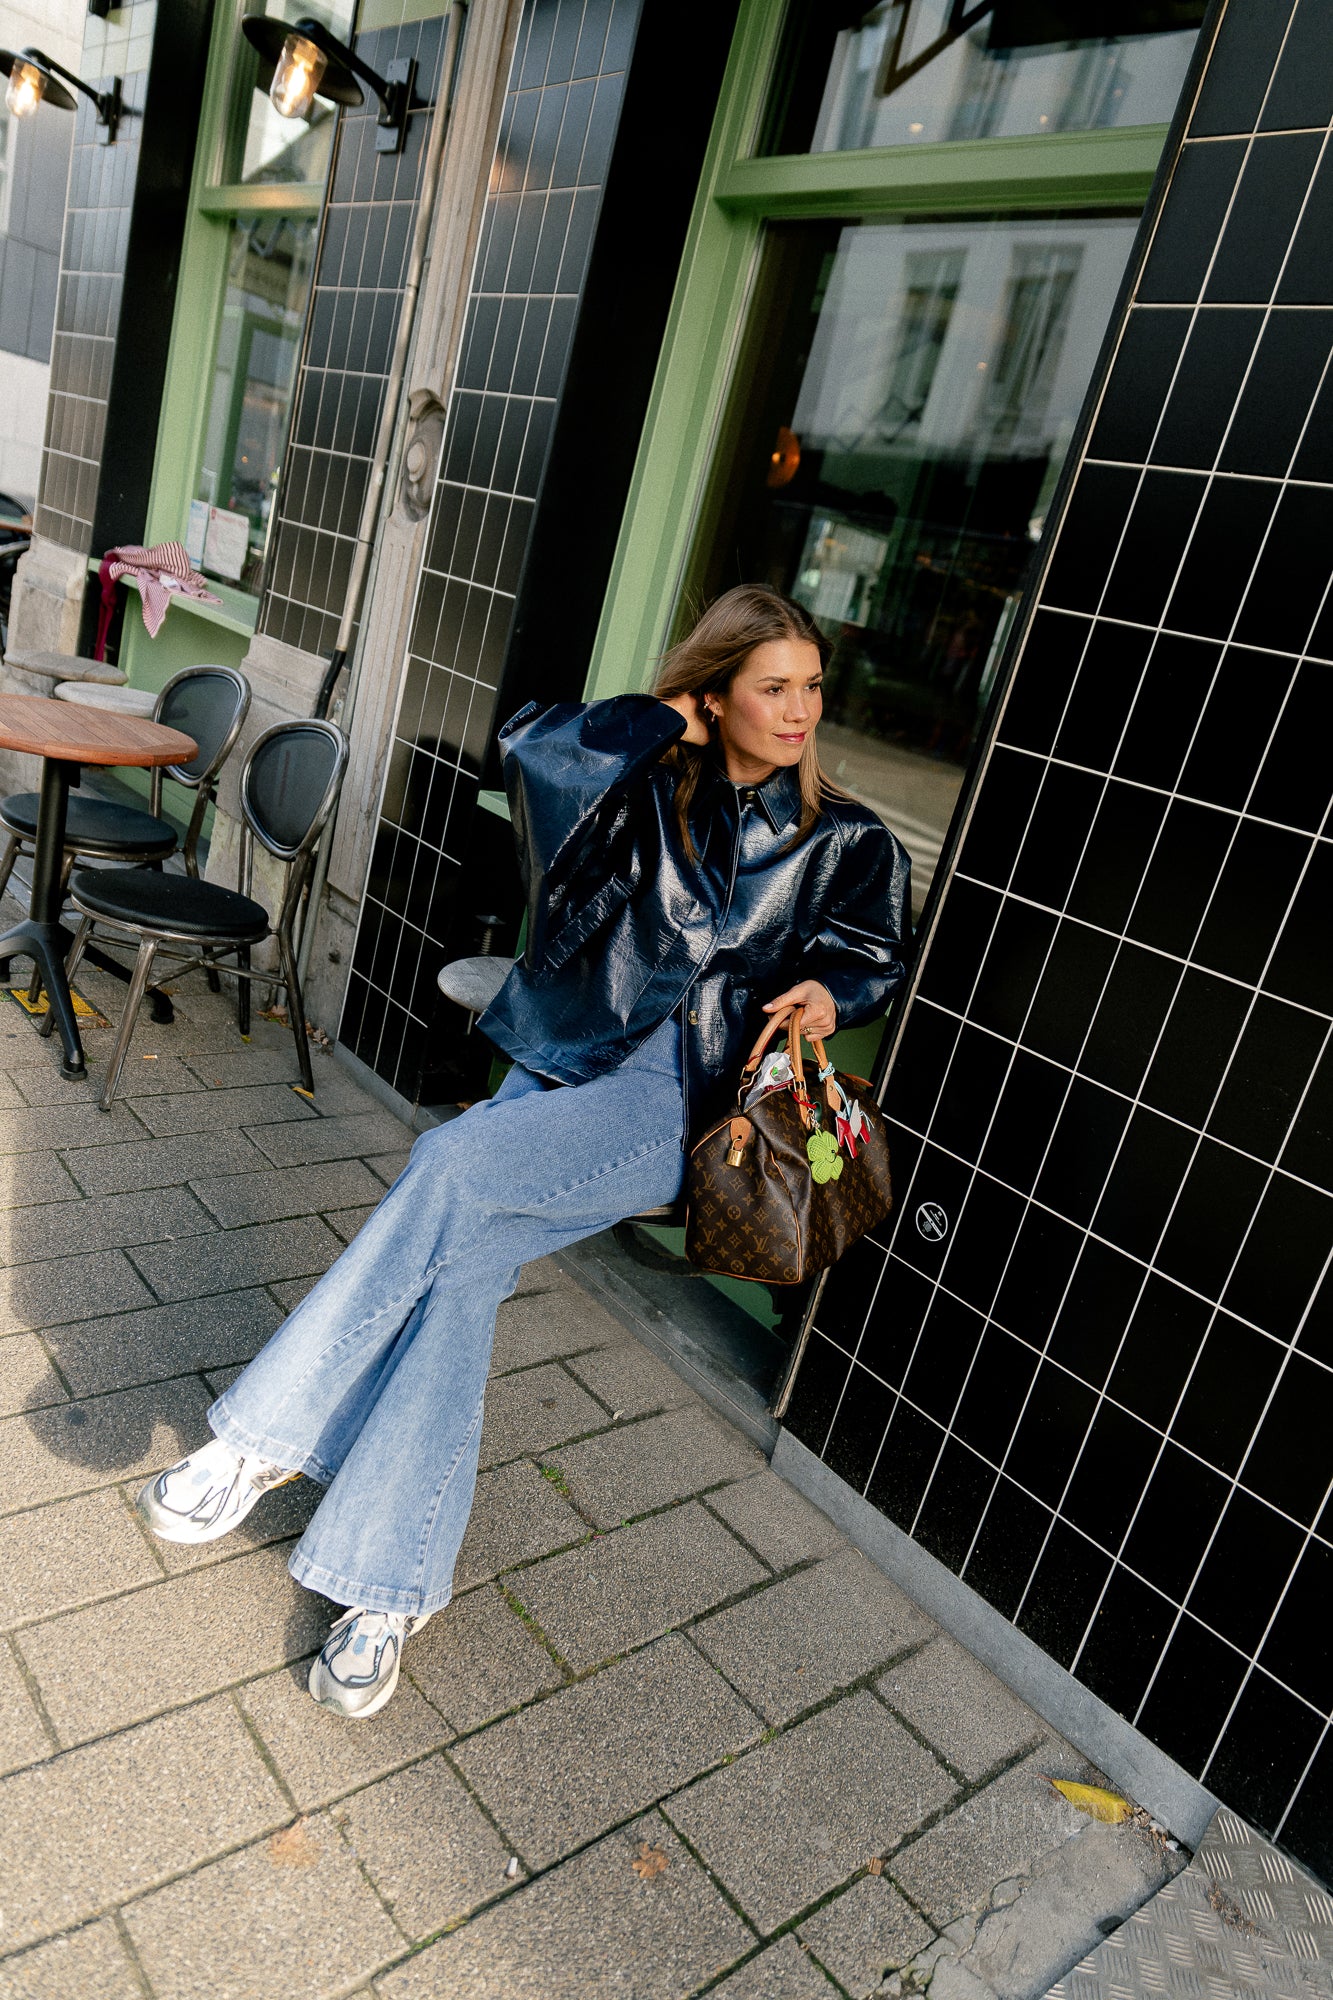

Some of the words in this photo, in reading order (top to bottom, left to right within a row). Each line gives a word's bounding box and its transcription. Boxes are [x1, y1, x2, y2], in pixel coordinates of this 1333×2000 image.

[702, 1170, 717, 1190] LV
[703, 1227, 717, 1246] LV
[753, 1235, 770, 1254] LV
